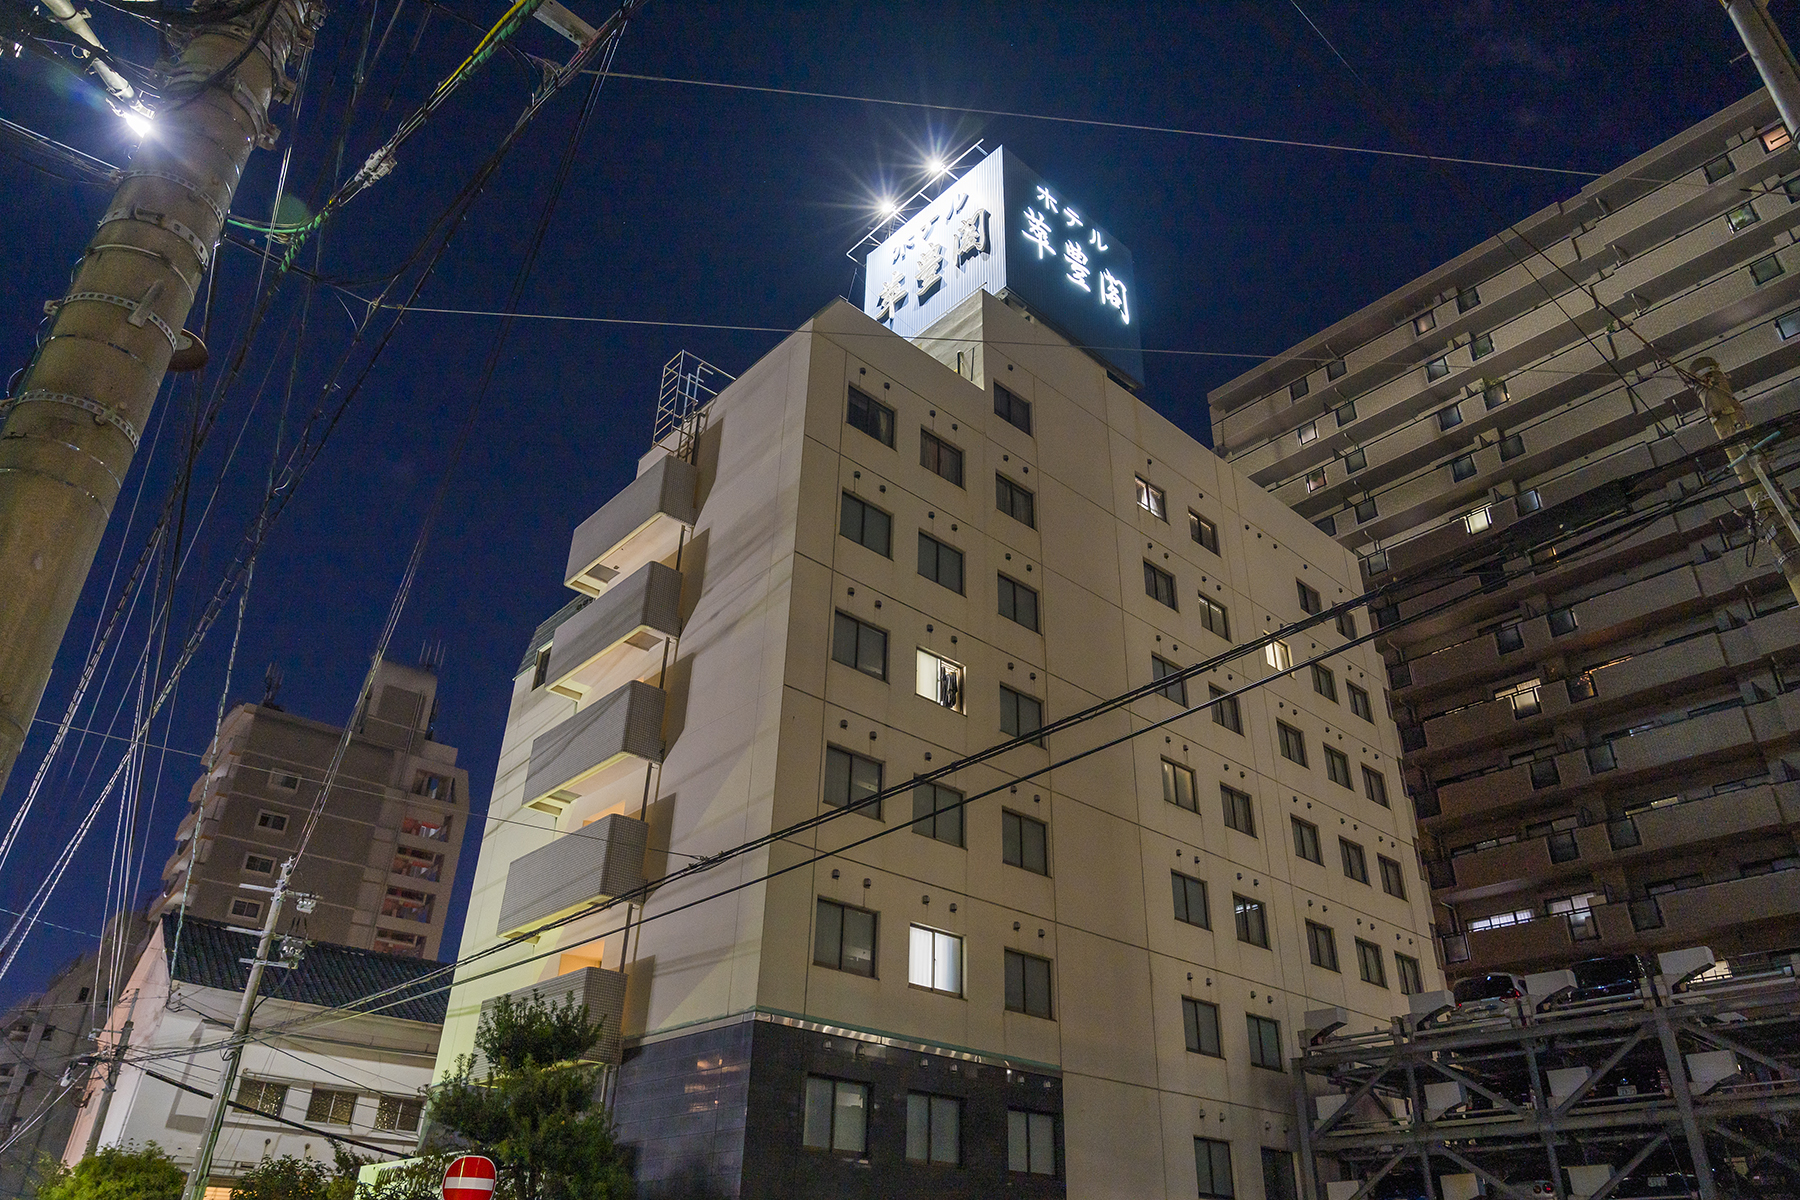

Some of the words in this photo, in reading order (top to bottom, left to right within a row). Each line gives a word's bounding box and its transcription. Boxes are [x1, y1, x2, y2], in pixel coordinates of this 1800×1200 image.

[890, 191, 969, 265] ホテル
[1036, 185, 1109, 252] ホテル
